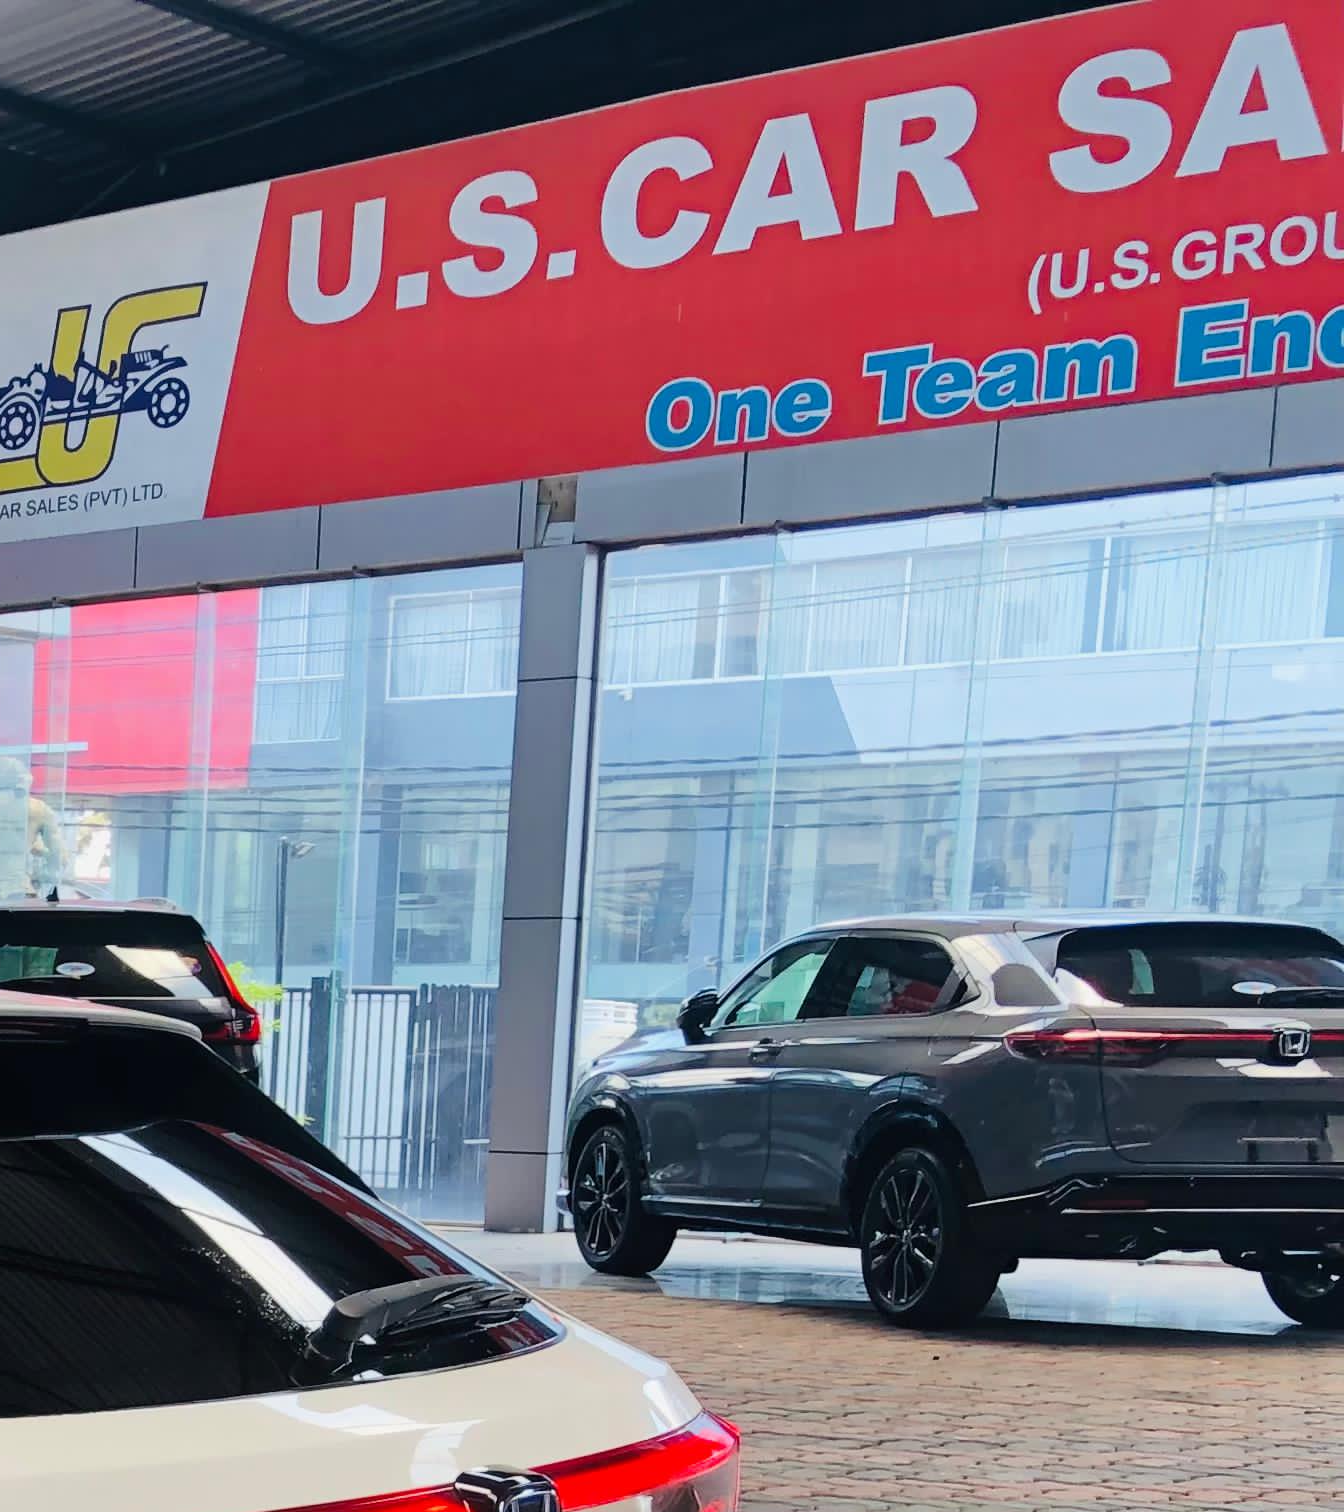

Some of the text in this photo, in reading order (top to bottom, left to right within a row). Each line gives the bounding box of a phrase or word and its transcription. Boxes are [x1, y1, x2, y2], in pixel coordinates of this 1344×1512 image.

[286, 82, 979, 326] U.S.CAR
[645, 375, 832, 454] One
[862, 328, 1140, 425] Team
[26, 494, 79, 517] SALES
[84, 487, 128, 513] (PVT)
